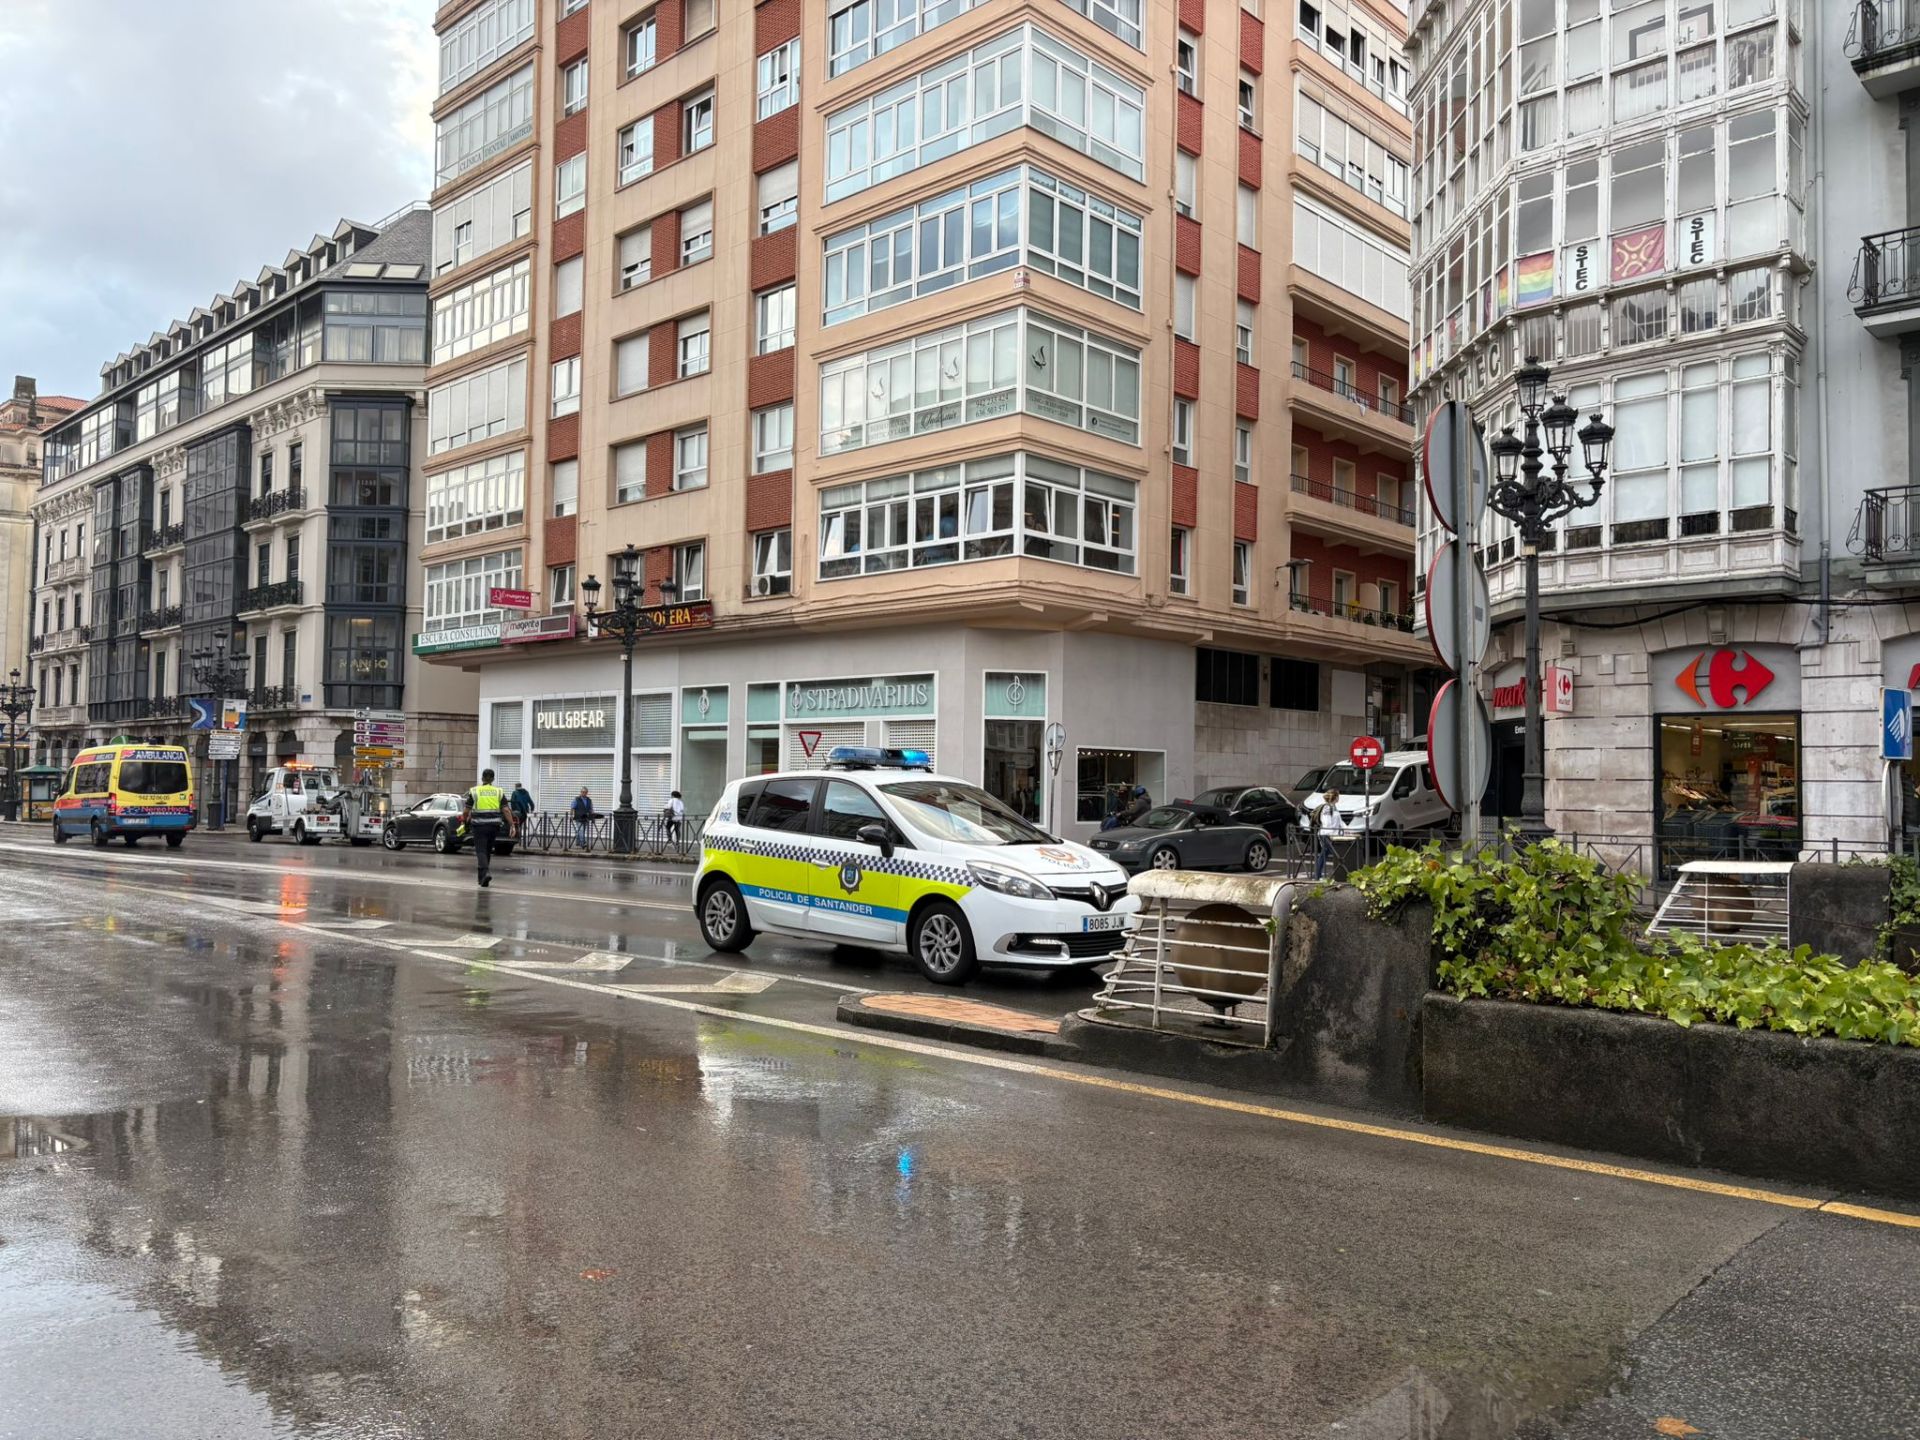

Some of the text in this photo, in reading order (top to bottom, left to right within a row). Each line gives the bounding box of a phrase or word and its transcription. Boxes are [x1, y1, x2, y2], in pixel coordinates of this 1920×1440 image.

[1691, 217, 1704, 264] STEC
[1575, 245, 1588, 291] STEC
[421, 631, 448, 644] ESCURA
[450, 626, 498, 642] CONSULTING
[806, 683, 928, 710] STRADIVARIUS
[537, 710, 605, 729] PULL&BEAR
[135, 751, 184, 760] AMBULANCIA
[759, 888, 873, 915] POLICIA DE SANTANDER
[1088, 917, 1109, 930] 8085
